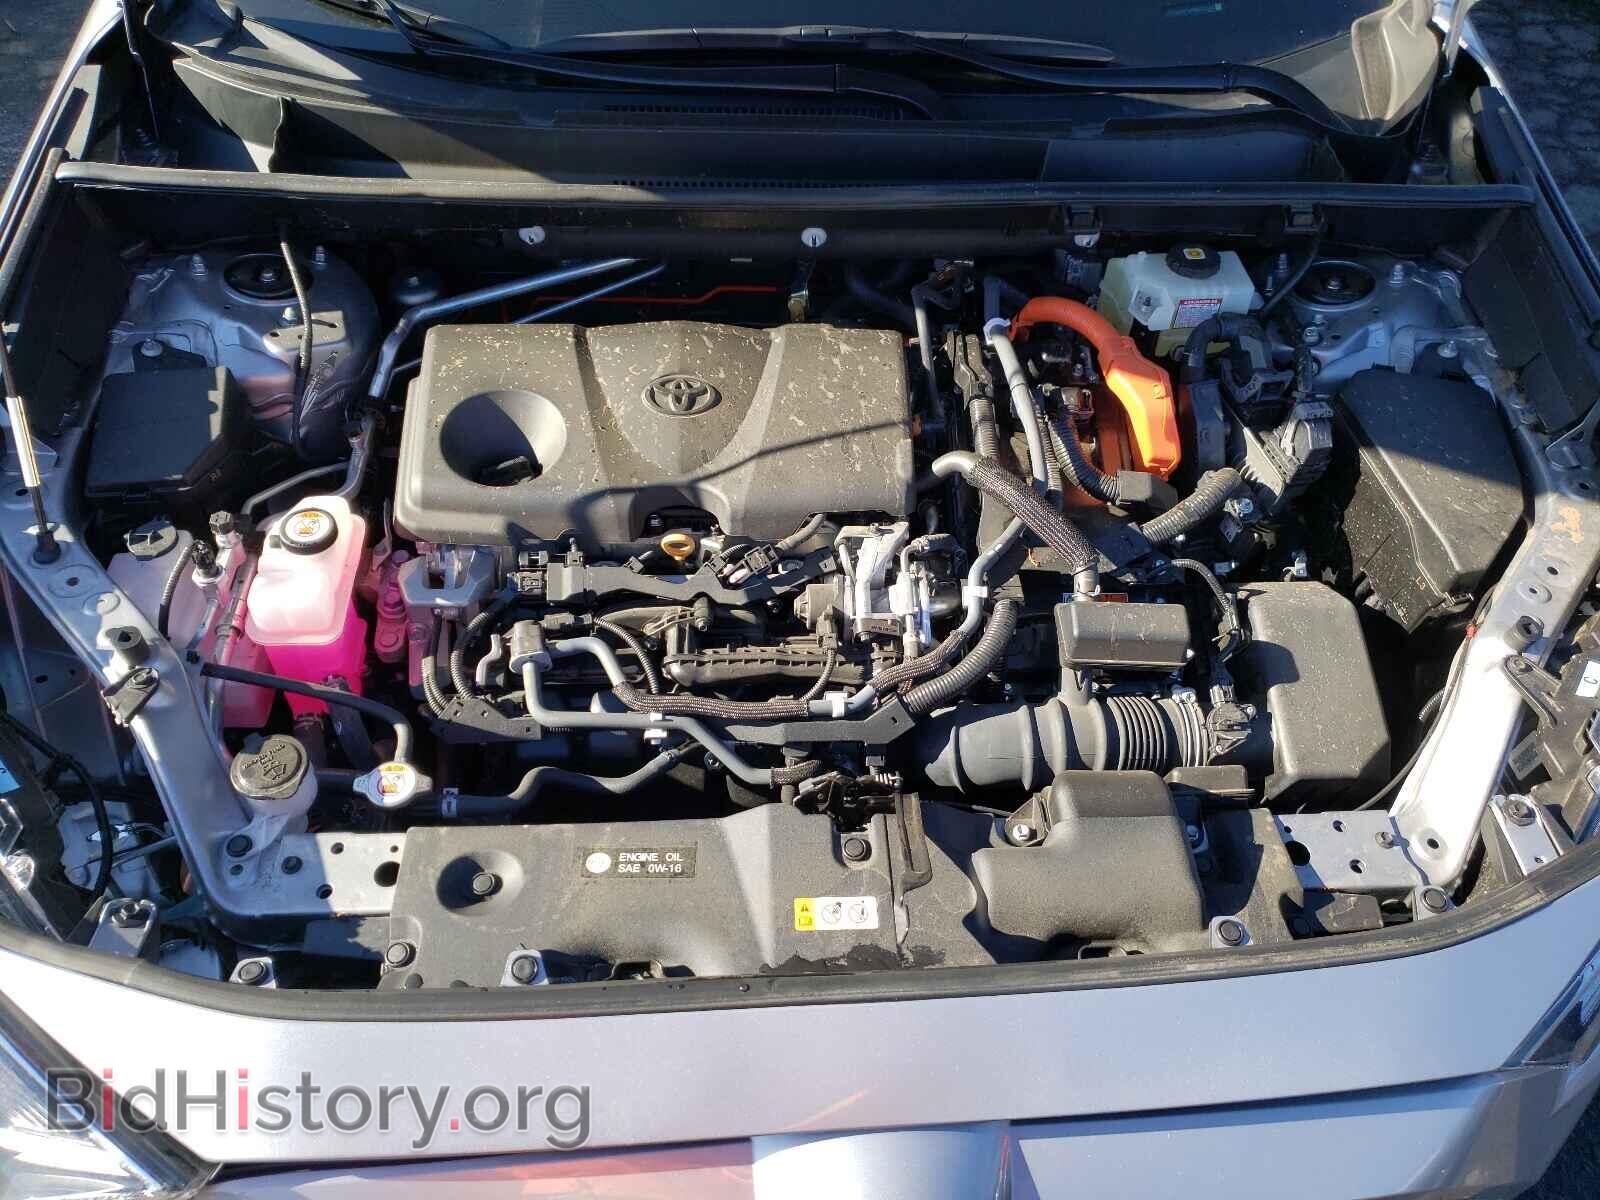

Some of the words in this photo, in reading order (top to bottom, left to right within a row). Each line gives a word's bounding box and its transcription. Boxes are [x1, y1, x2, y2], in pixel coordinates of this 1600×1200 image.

[619, 852, 659, 862] ENGINE
[665, 852, 684, 862] OIL
[618, 863, 641, 873] SAE
[647, 863, 683, 873] 0W-16
